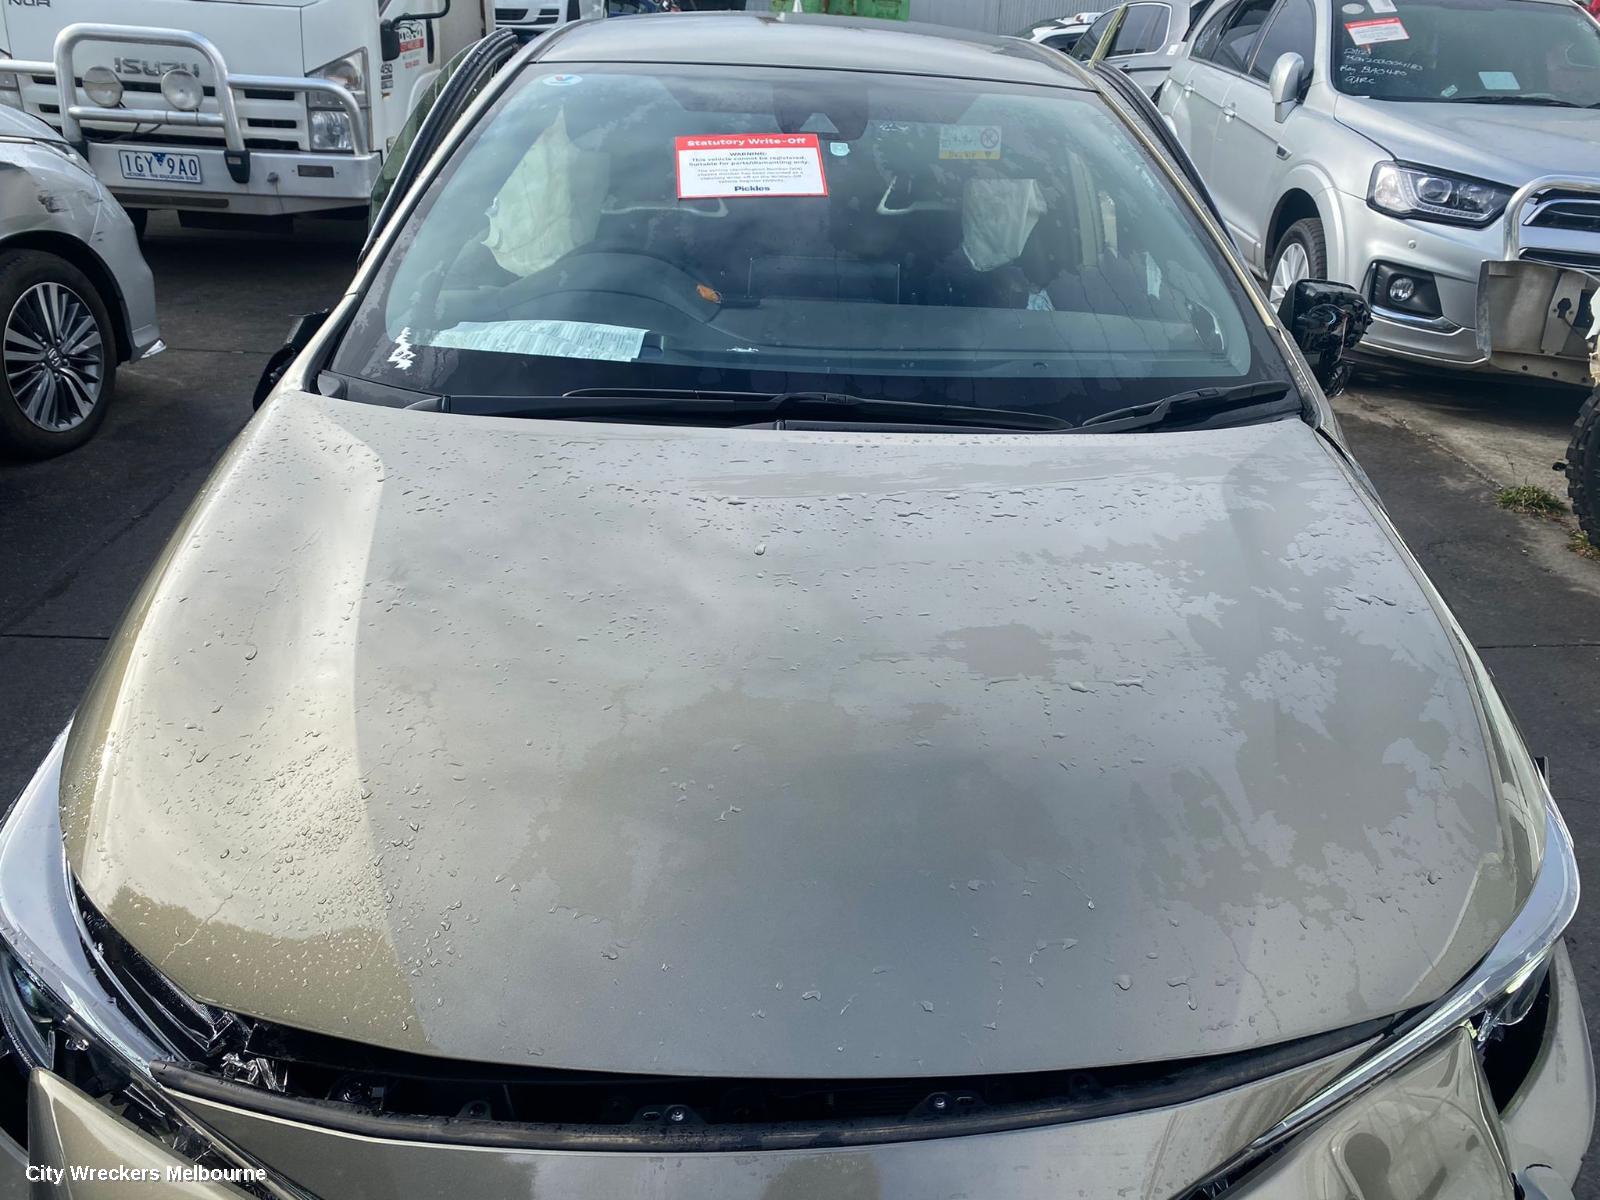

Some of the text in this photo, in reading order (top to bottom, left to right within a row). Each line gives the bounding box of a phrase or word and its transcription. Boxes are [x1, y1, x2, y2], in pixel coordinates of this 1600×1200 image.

[114, 56, 200, 78] ISUZU
[687, 137, 806, 147] Statutory Write-Off
